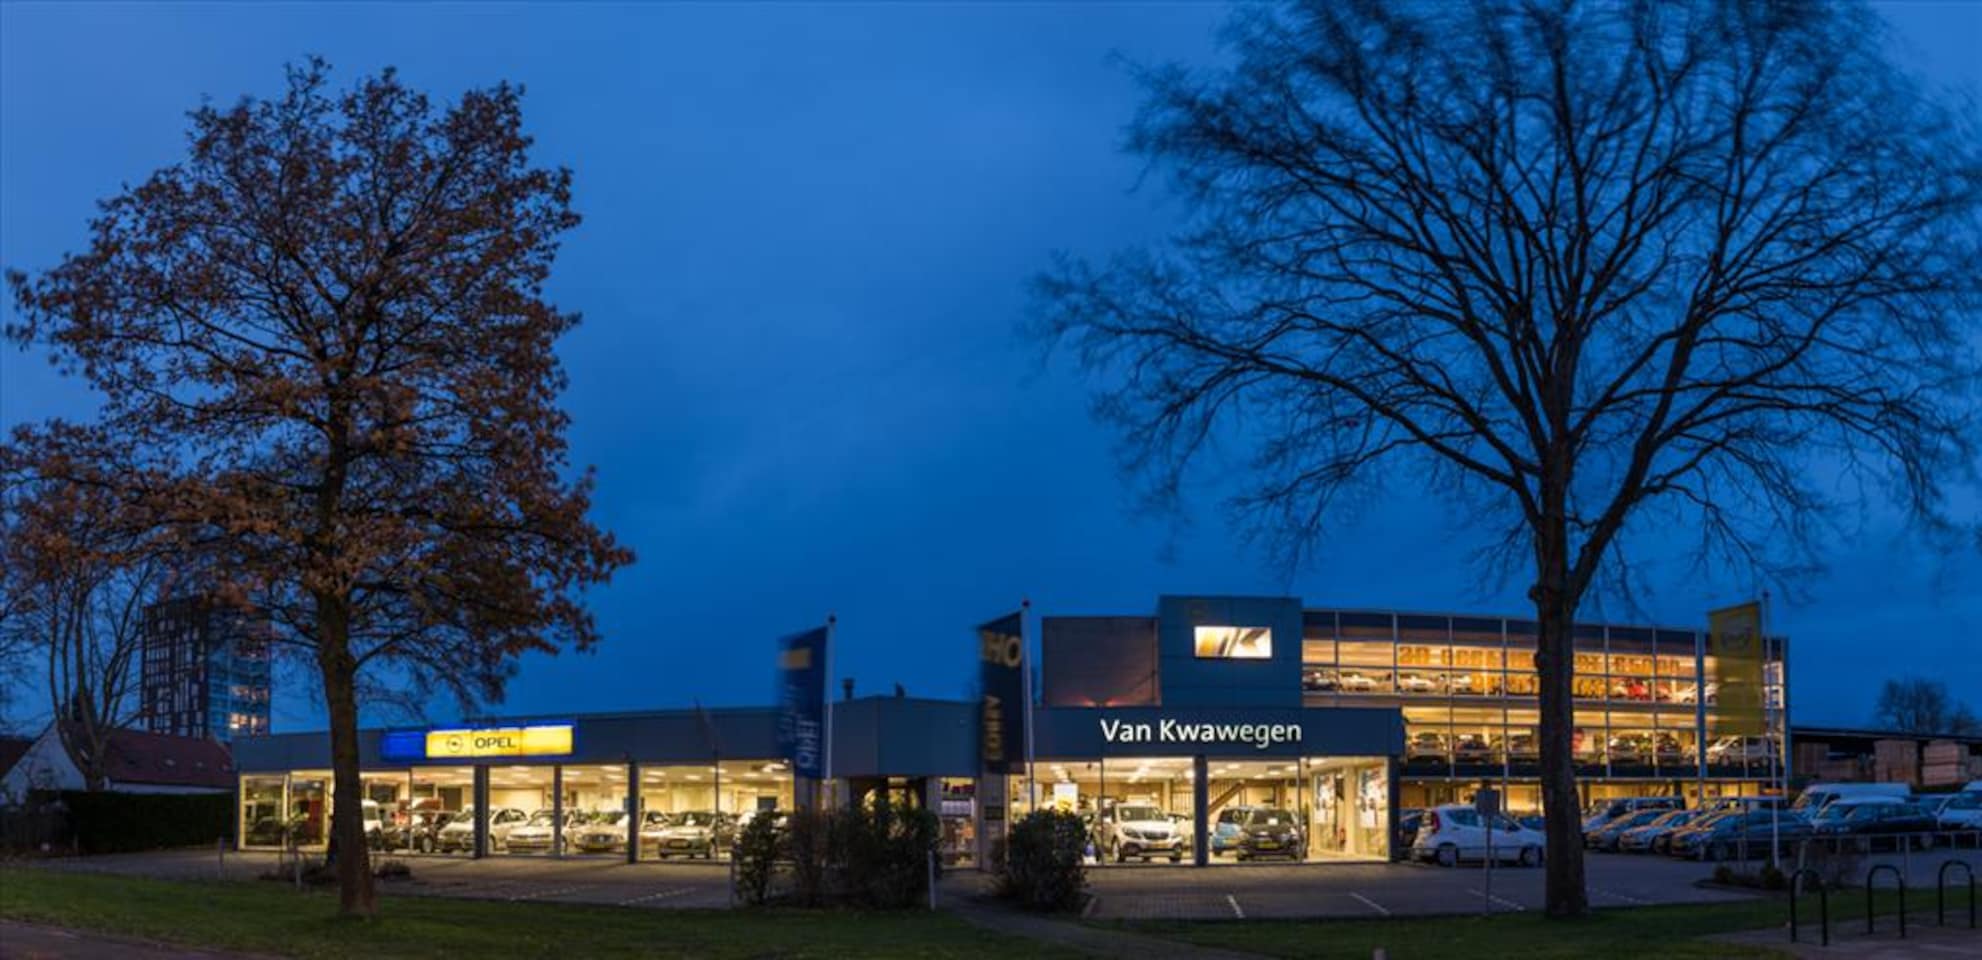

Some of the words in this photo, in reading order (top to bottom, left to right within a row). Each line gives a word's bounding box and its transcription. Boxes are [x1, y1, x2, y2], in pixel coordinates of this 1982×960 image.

[474, 736, 516, 749] OPEL
[1100, 718, 1151, 742] Van
[1160, 719, 1302, 748] Kwawegen
